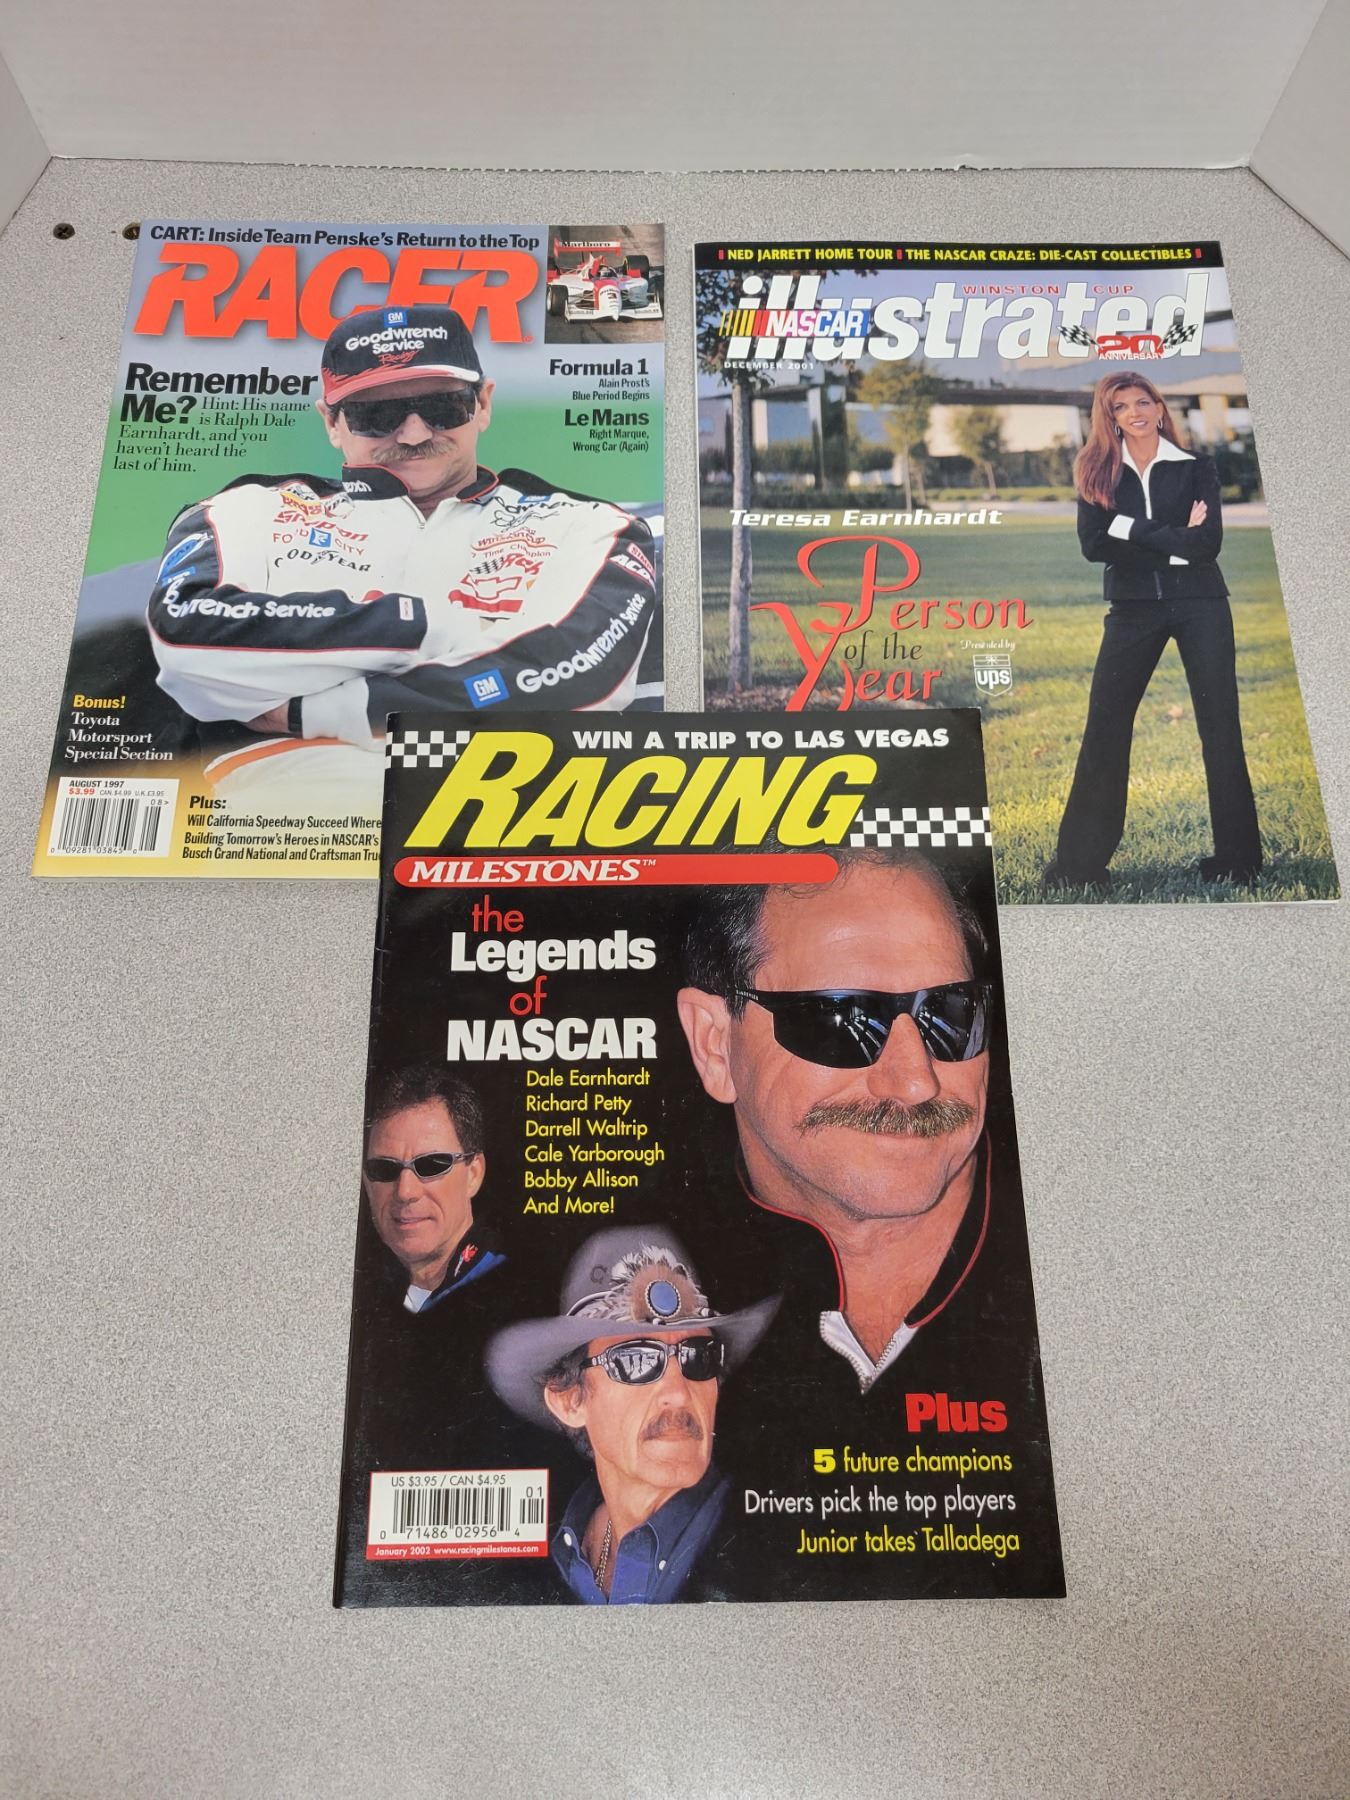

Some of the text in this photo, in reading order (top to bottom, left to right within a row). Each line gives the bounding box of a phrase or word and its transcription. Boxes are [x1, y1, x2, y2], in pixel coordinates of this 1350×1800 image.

[150, 226, 540, 251] CART: Inside Team Penske's Return to the Top
[728, 248, 1192, 262] NED JARRETT HOME TOUR THE NASCAR CRAZE: DIE-CAST COLLECTIBLES
[963, 285, 1135, 294] WINSTON CUP
[727, 273, 1210, 361] illustrated
[766, 310, 864, 336] NASCAR
[345, 326, 448, 351] Goodwrench
[372, 339, 424, 354] Service
[723, 361, 814, 370] DECEMBER 2001
[1099, 352, 1165, 361] ANNIVERSARY
[549, 358, 649, 376] Formula 1
[125, 362, 318, 395] Remember
[598, 378, 650, 388] Alain Prost's
[202, 396, 310, 412] Hint: His name
[572, 390, 650, 402] Blue Period Begins
[120, 393, 197, 424] Me?
[565, 409, 649, 426] Le Mans
[200, 413, 296, 429] is Ralph Dale
[120, 424, 268, 445] Earnhardt, and you
[589, 429, 649, 440] Right Marque,
[116, 440, 247, 458] haven't heard the
[573, 440, 649, 453] Wrong Car (Again)
[113, 456, 196, 472] last of him.
[729, 509, 1003, 527] Teresa Earnhardt
[797, 535, 1034, 634] Person
[264, 601, 336, 618] Service
[516, 617, 628, 693] Goodwrench
[748, 602, 942, 712] Year
[844, 629, 922, 670] of the
[473, 676, 500, 701] GM
[976, 670, 1010, 690] ups
[73, 694, 126, 709] Bonus!
[71, 711, 120, 729] Toyota
[67, 728, 153, 746] Motorsport
[572, 728, 950, 749] WIN A TRIP TO LAS VEGAS
[64, 745, 173, 763] Special Section
[404, 731, 878, 847] RACING
[189, 795, 227, 809] Plus:
[187, 814, 382, 830] Will California Speedway Succeed Where
[184, 832, 379, 846] Building Tomorrow's Heroes in NASCAR's
[66, 846, 92, 854] 09281
[182, 847, 361, 861] Busch Grand National and Craftsman
[471, 894, 525, 933] the
[451, 929, 656, 983] Legends
[509, 975, 548, 1016] of
[447, 1018, 657, 1061] NASCAR
[526, 1067, 650, 1086] Dale Earnhardt
[526, 1092, 632, 1115] Richard Petty
[526, 1117, 648, 1141] Darrell Waltrip
[525, 1142, 665, 1166] Cale Yarborough
[524, 1168, 638, 1193] Bobby Allison
[523, 1194, 614, 1214] And More!
[905, 1392, 1008, 1433] Plus
[814, 1445, 1013, 1479] 5 future champions
[391, 1476, 405, 1487] US
[408, 1475, 437, 1487] $3.95
[449, 1475, 474, 1486] CAN
[477, 1474, 506, 1486] $4.95
[744, 1484, 1016, 1520] Drivers pick the top players
[379, 1526, 520, 1540] 0 71486 02956 4
[796, 1523, 1020, 1558] Junior takes Talladega
[375, 1545, 539, 1557] January 2002 www.racingmilestones.com
